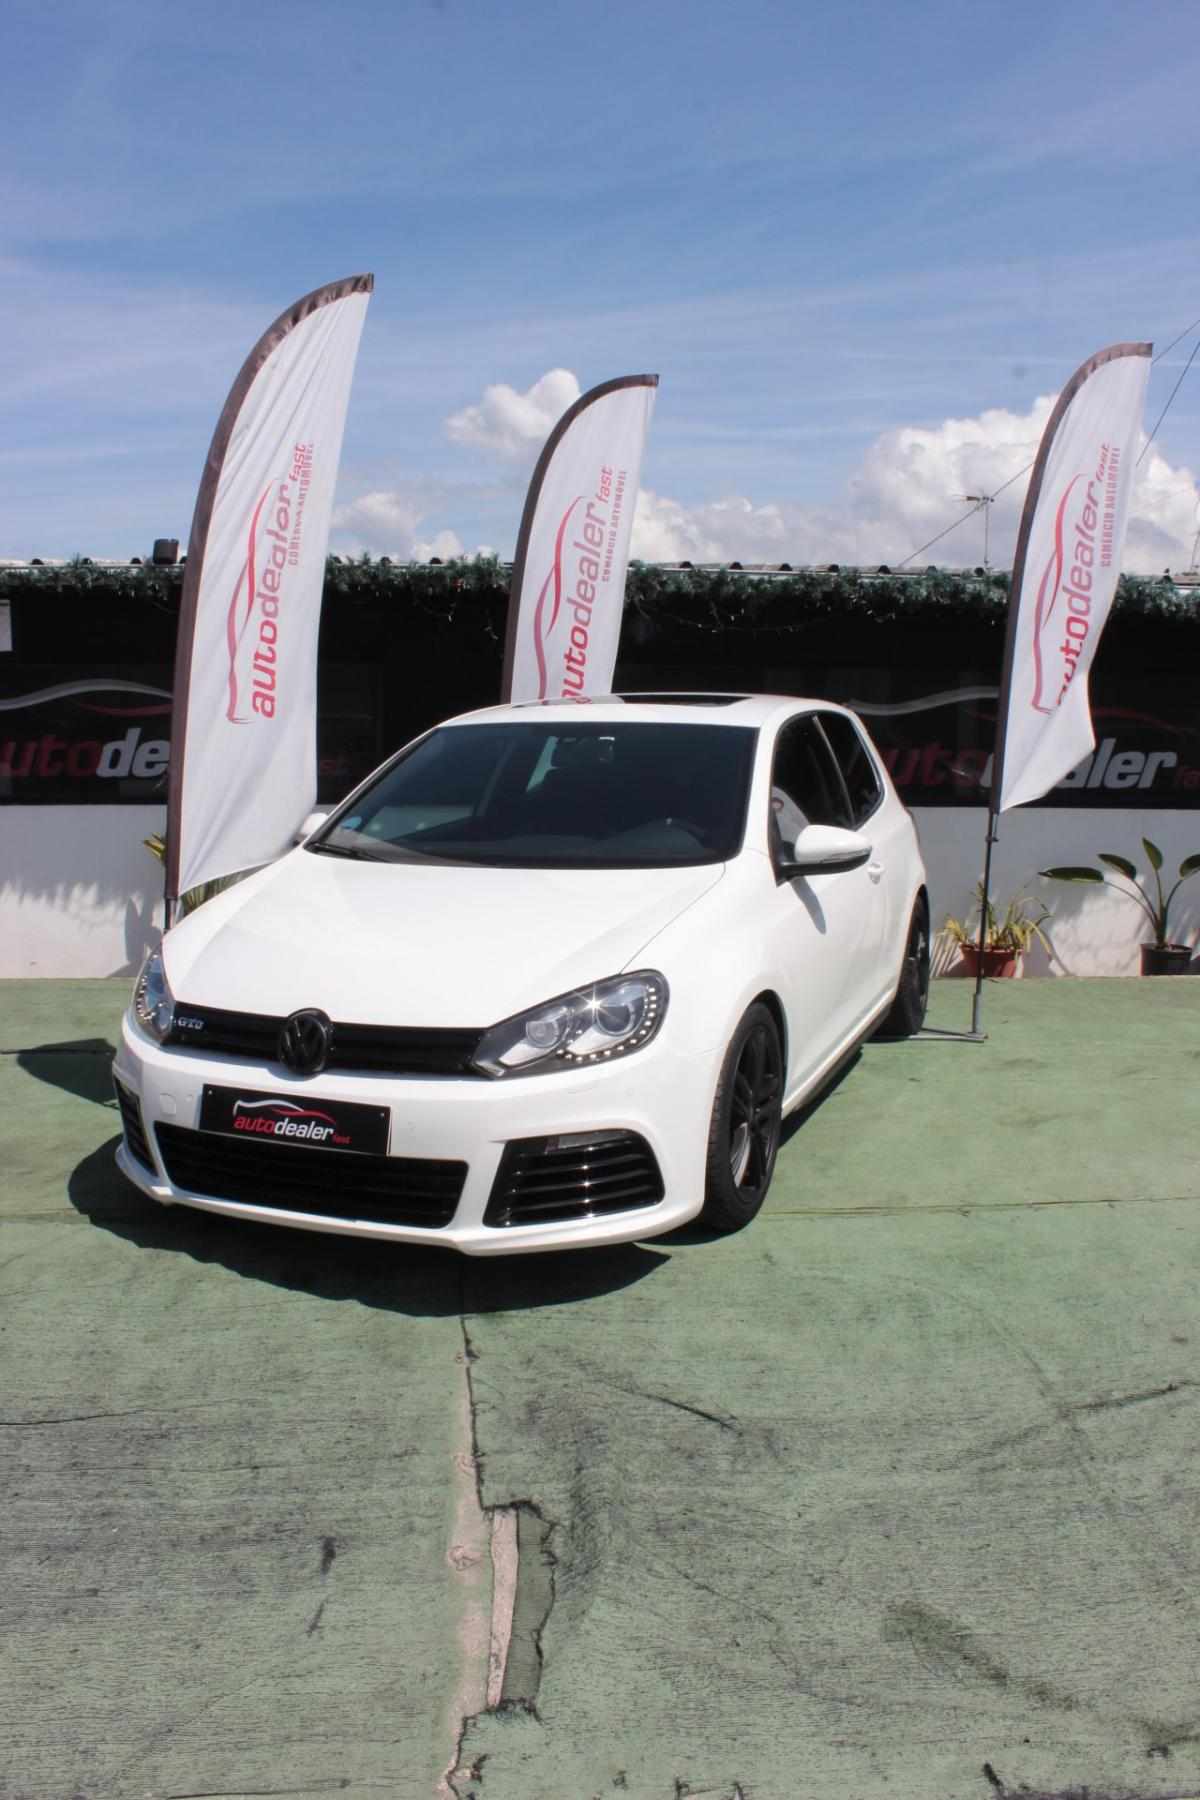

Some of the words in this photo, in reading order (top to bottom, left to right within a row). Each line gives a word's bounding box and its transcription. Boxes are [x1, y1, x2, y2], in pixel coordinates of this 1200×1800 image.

[596, 464, 613, 504] fast
[252, 484, 290, 719] autodealer
[288, 442, 306, 481] fast
[1055, 480, 1099, 706] utodealer
[233, 1115, 334, 1141] autodealer
